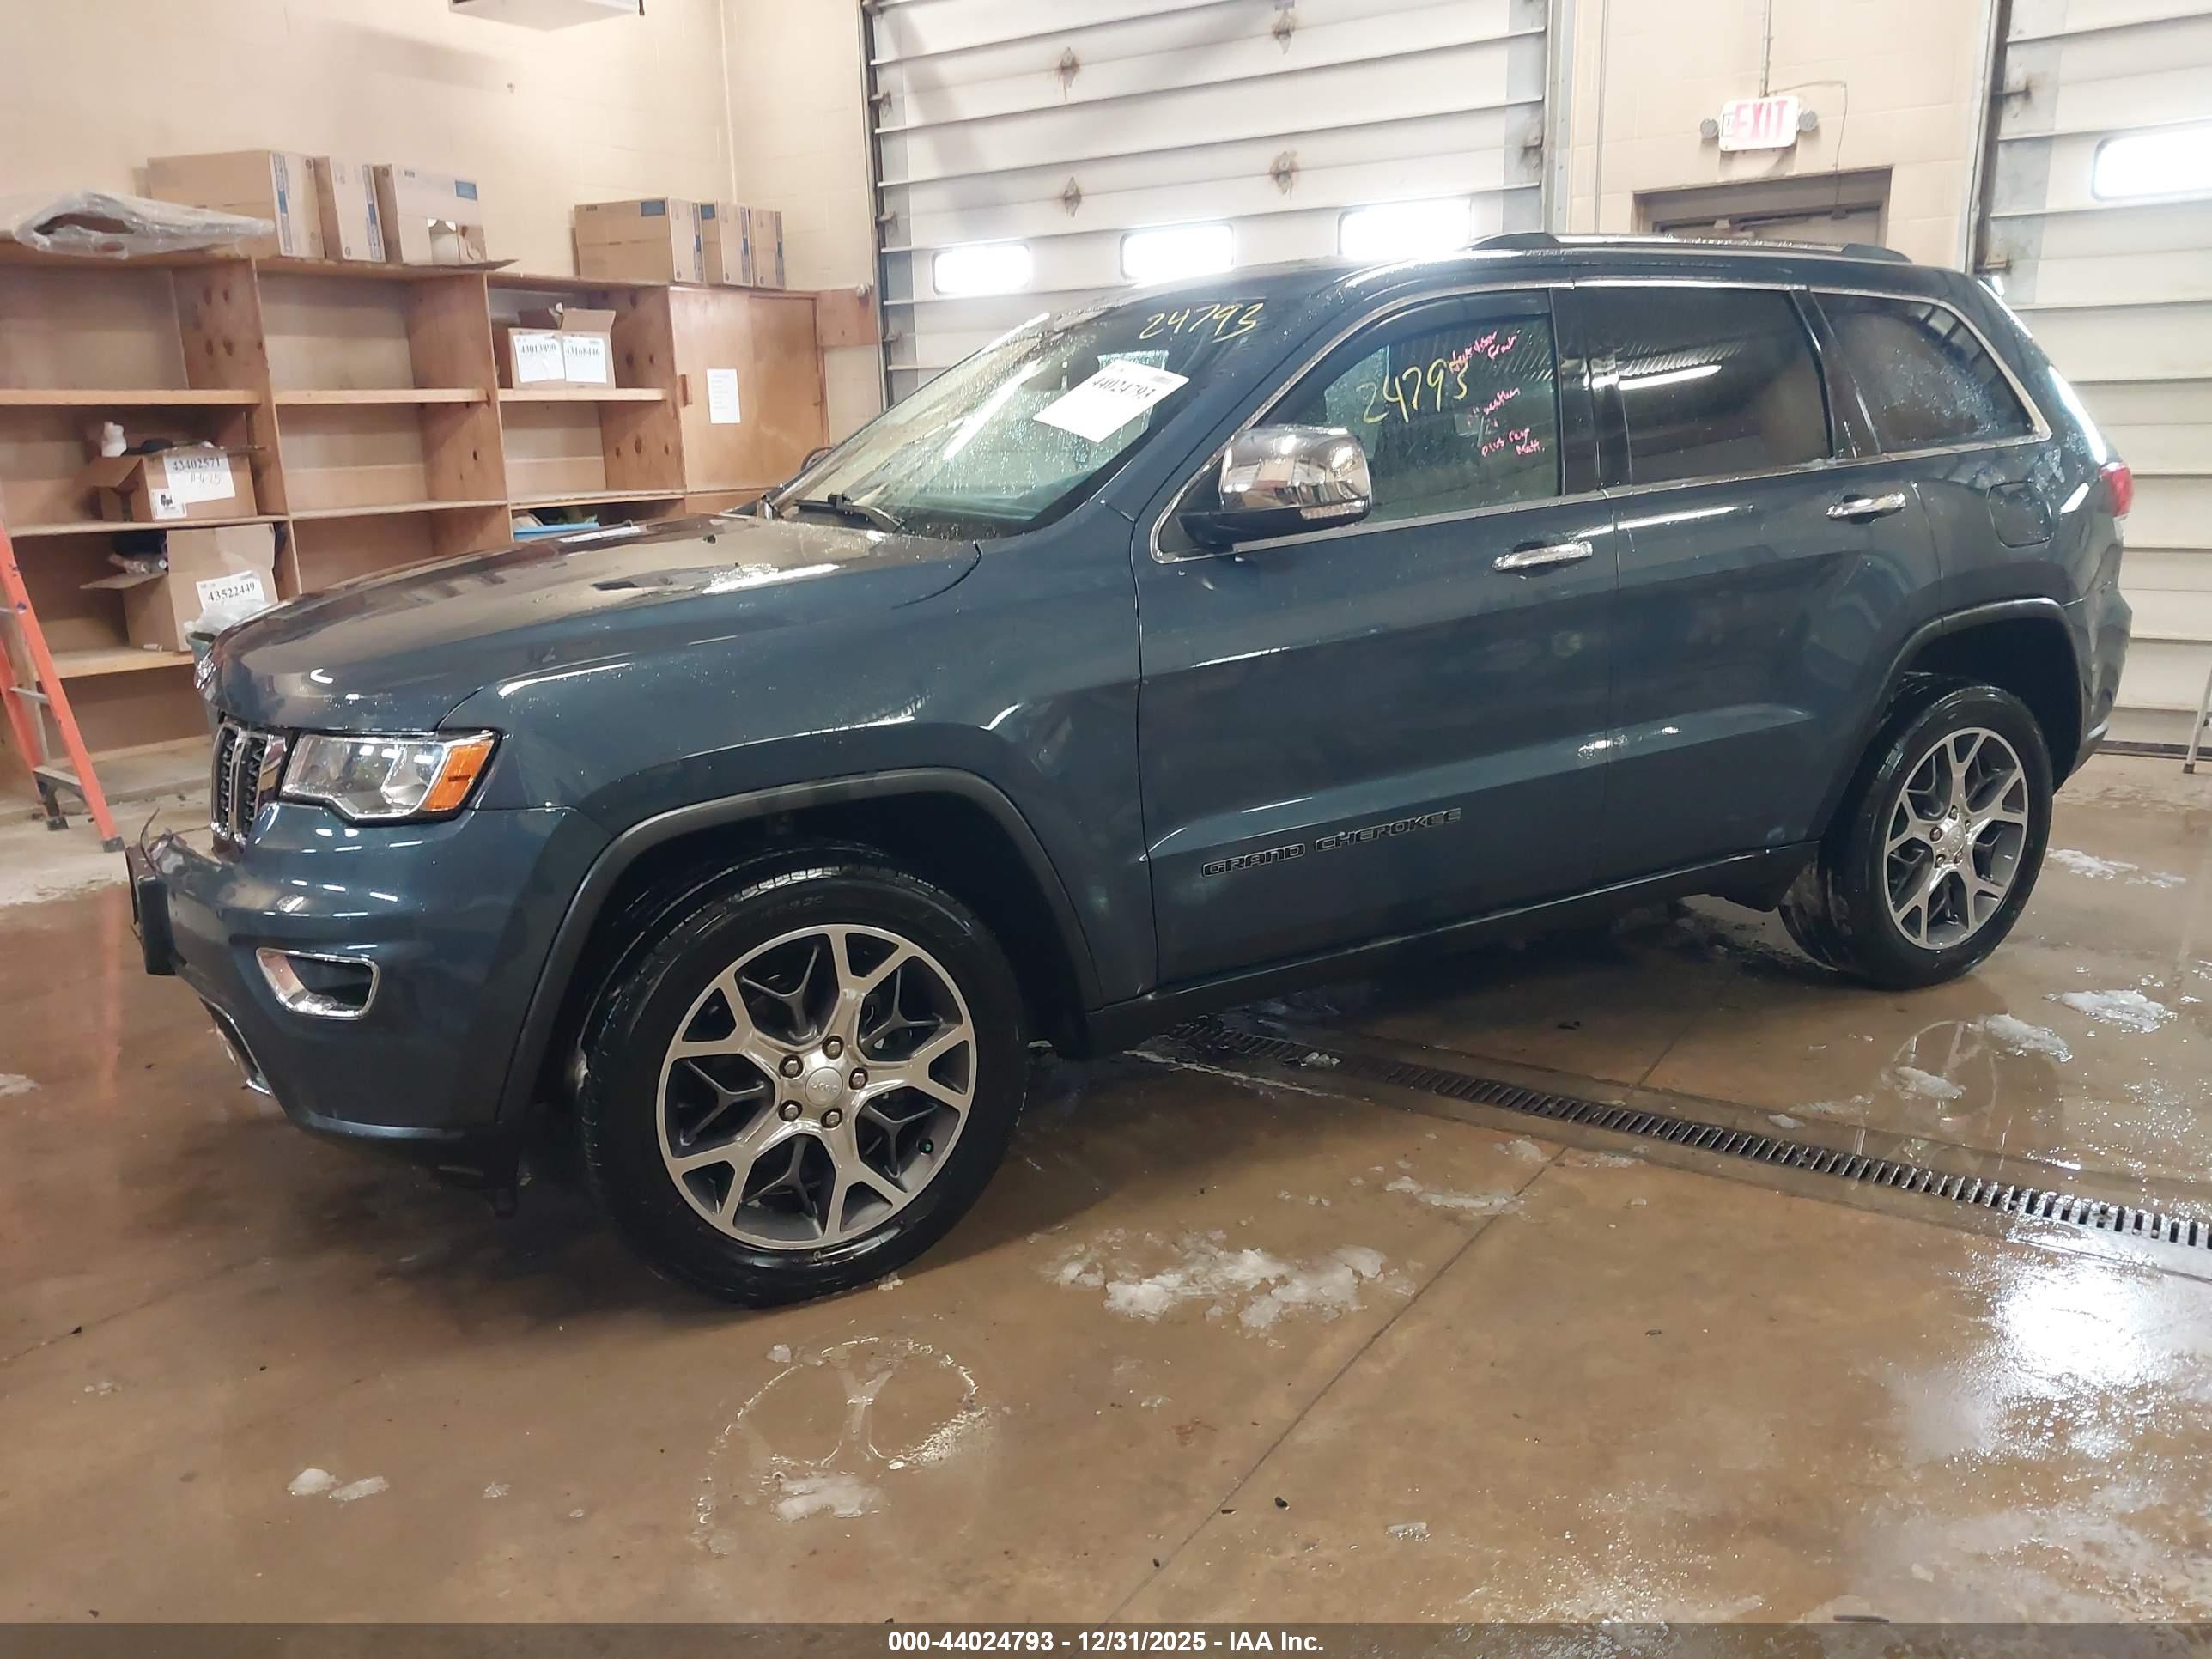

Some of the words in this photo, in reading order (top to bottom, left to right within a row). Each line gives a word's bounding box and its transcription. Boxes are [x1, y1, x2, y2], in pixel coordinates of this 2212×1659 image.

[1733, 100, 1788, 141] EXIT
[1139, 302, 1264, 343] 24793
[1092, 376, 1157, 400] 44024793
[1356, 357, 1468, 424] 24793
[173, 456, 221, 471] 43402571
[209, 582, 255, 602] 43522449
[1202, 842, 1305, 878] GRAND
[1316, 808, 1462, 852] CHEROKEE
